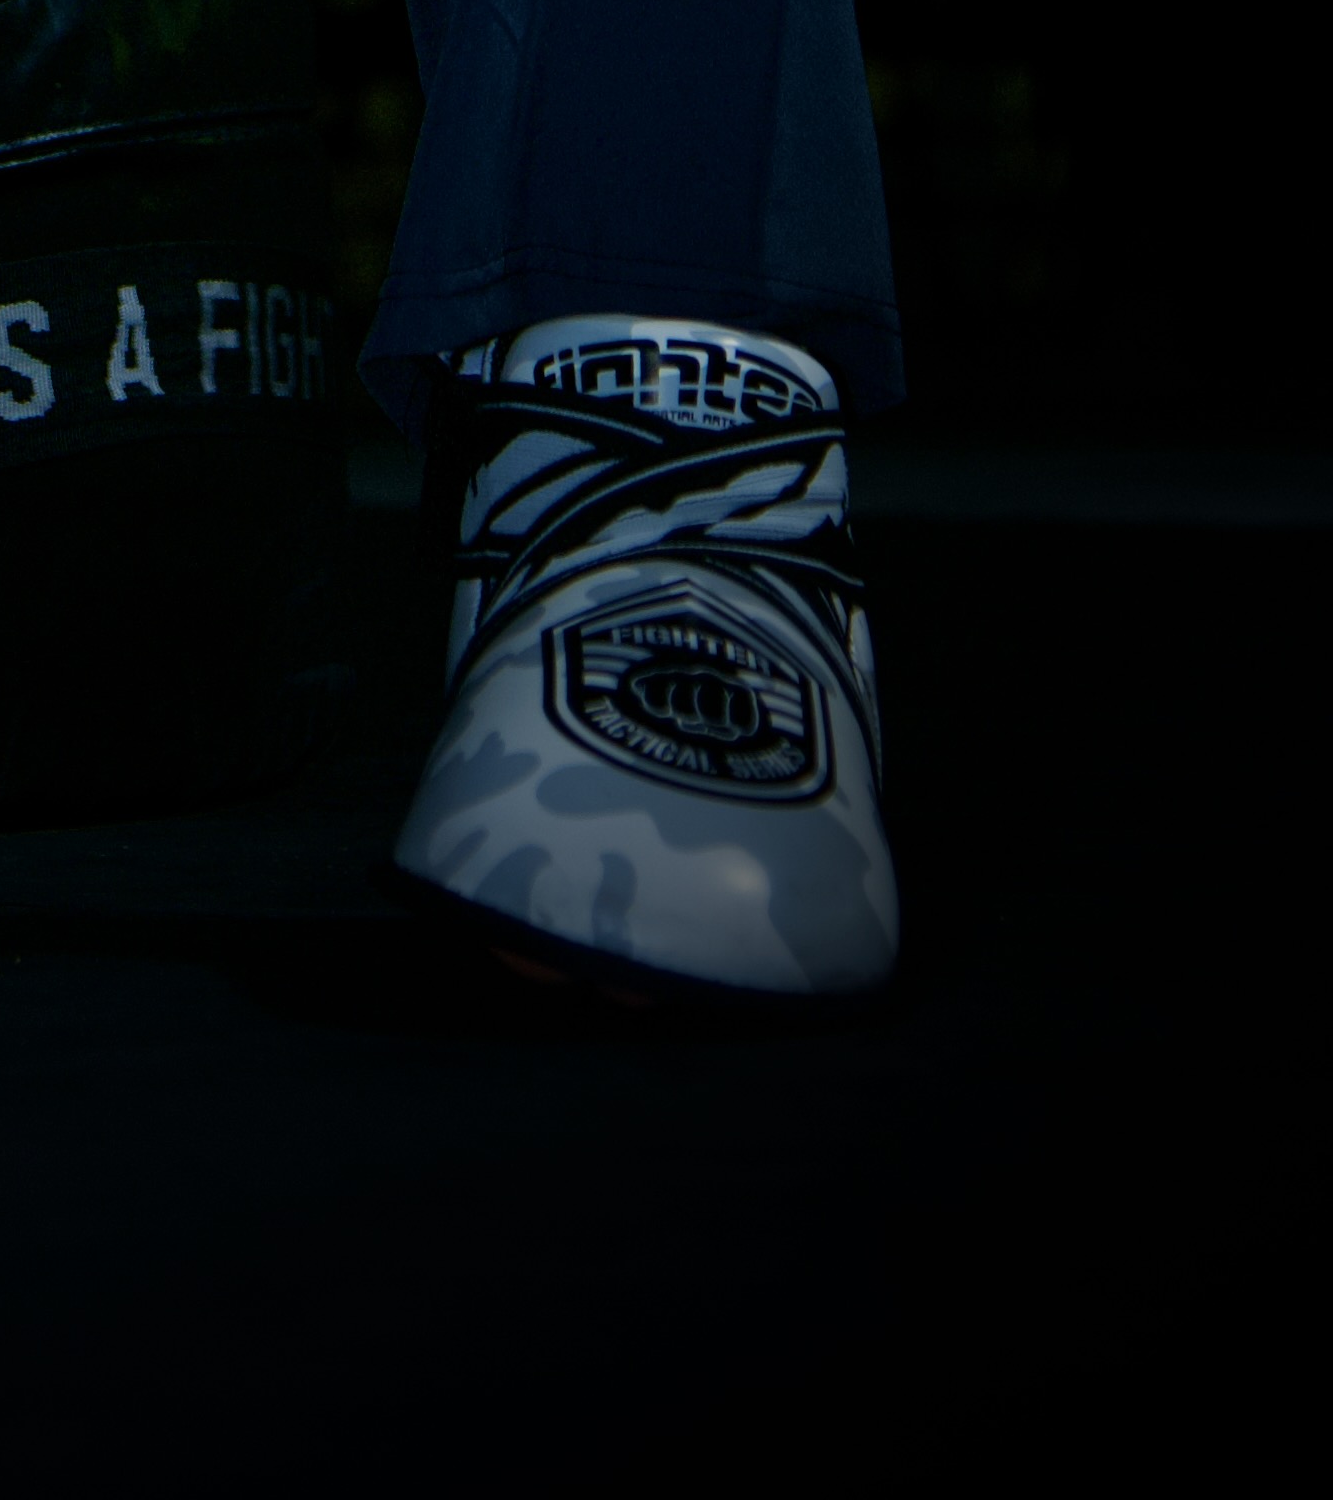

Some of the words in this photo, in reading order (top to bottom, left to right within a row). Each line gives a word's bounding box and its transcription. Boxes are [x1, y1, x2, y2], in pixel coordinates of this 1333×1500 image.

[105, 284, 166, 402] A
[196, 278, 334, 400] FIGH
[583, 695, 718, 776] TACTICAL
